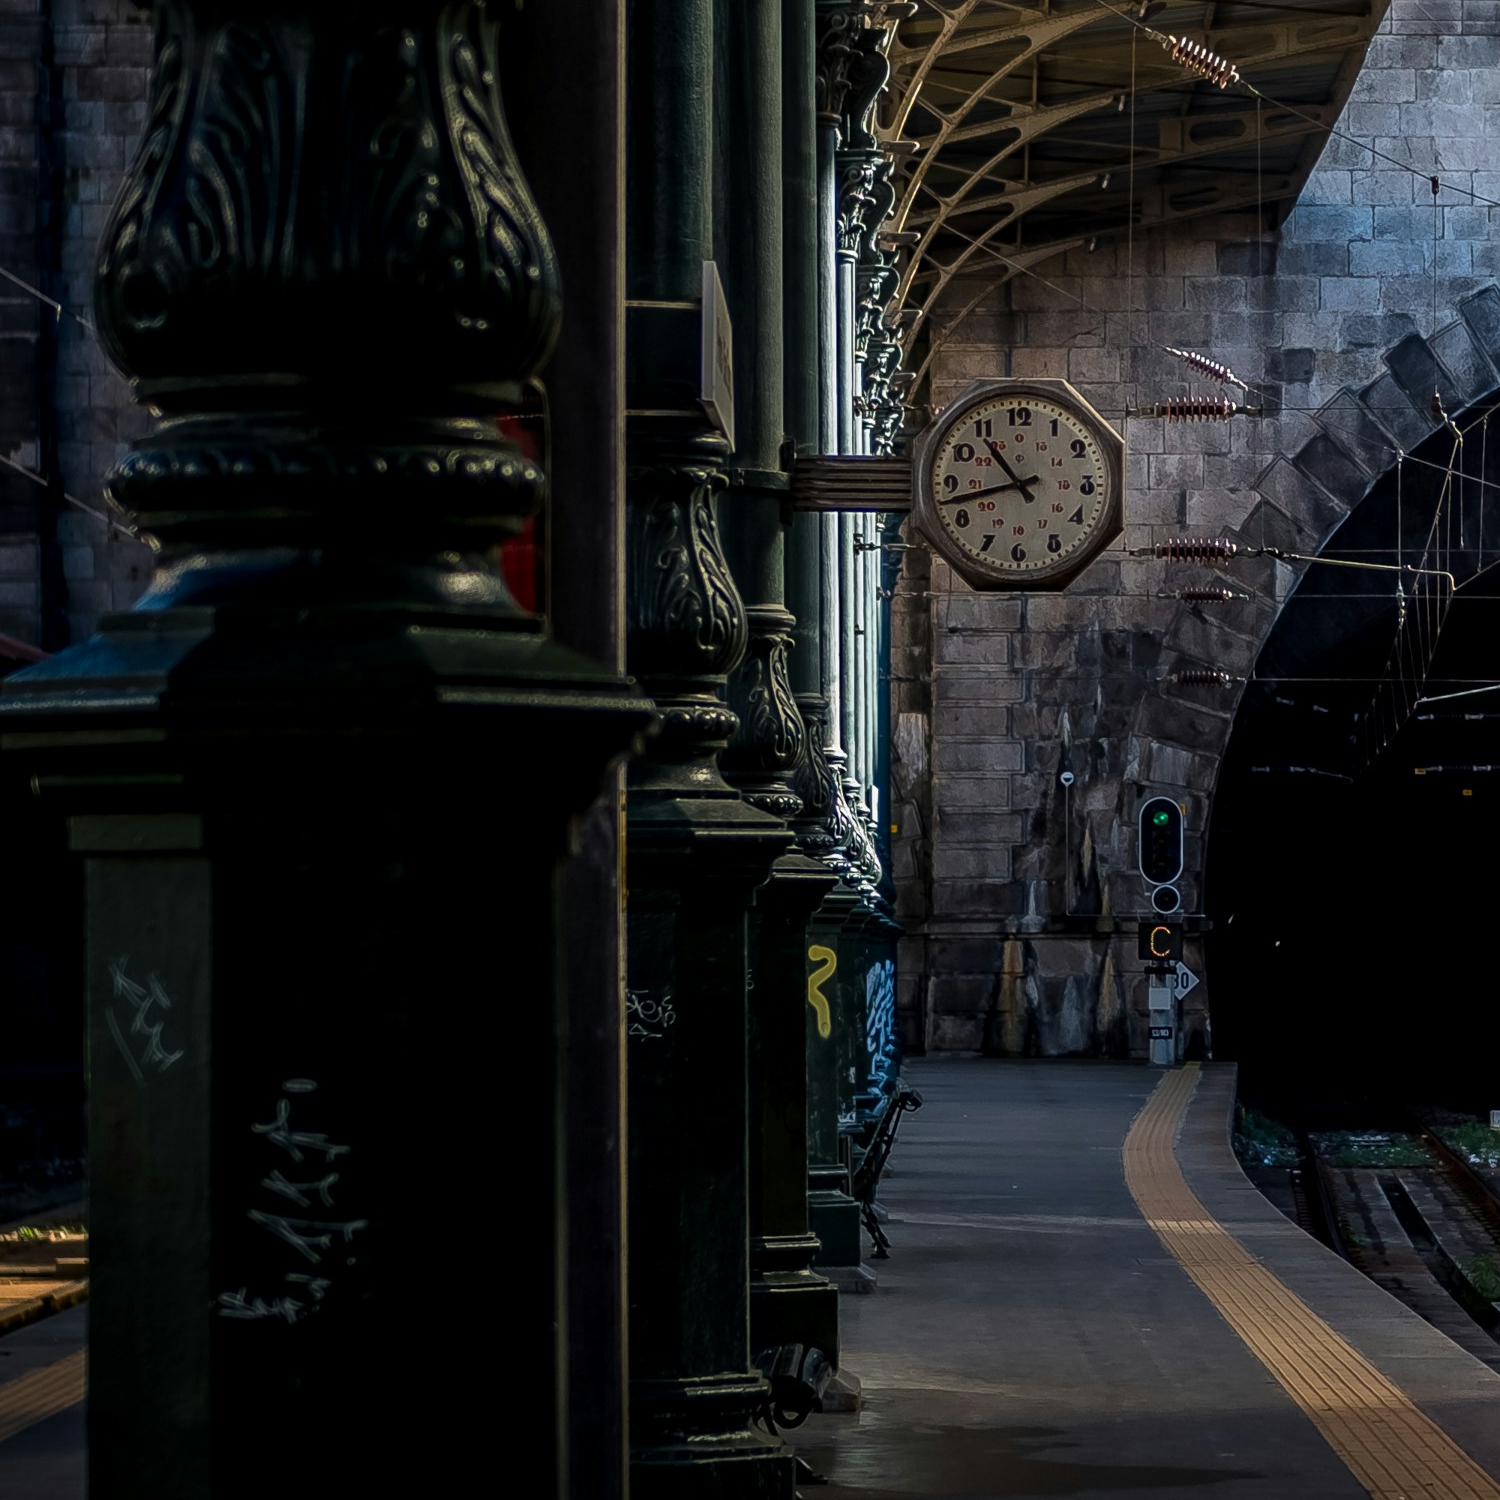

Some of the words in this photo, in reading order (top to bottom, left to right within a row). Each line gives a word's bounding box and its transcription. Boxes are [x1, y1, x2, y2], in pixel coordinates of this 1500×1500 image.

[1007, 407, 1032, 426] 12
[974, 419, 992, 438] 11
[1050, 418, 1059, 437] 1
[1014, 433, 1025, 443] 0
[953, 443, 975, 462] 10
[1070, 439, 1087, 459] 2
[974, 456, 992, 467] 22
[1051, 457, 1063, 468] 14
[943, 474, 958, 494] 9
[968, 479, 982, 490] 21
[1080, 475, 1095, 496] 3
[978, 501, 996, 512] 20
[1051, 503, 1063, 513] 16
[1068, 504, 1084, 525] 4
[955, 509, 970, 528] 8
[992, 519, 1004, 529] 19
[1037, 519, 1048, 529] 17
[1012, 526, 1025, 536] 18
[980, 534, 996, 551] 7
[1048, 534, 1062, 553] 5
[1011, 543, 1026, 562] 6
[1150, 926, 1172, 957] C
